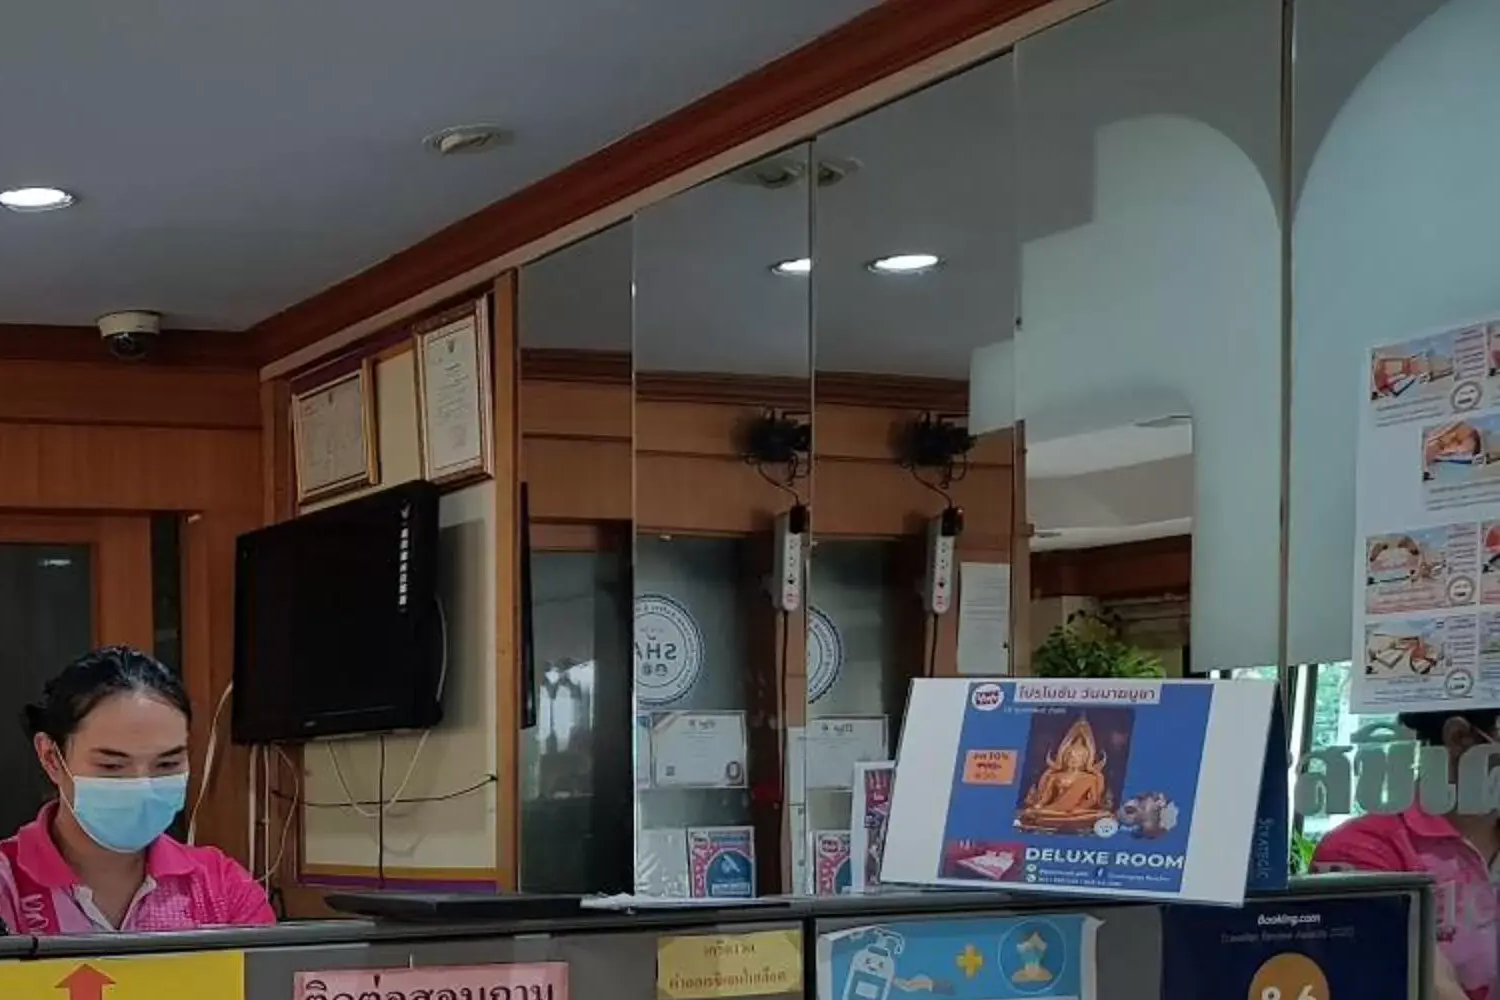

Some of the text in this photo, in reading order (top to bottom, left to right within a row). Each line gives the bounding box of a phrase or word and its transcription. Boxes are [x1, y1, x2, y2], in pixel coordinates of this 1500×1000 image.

[1024, 847, 1184, 870] DELUXE ROOM
[1257, 914, 1321, 927] Booking.com
